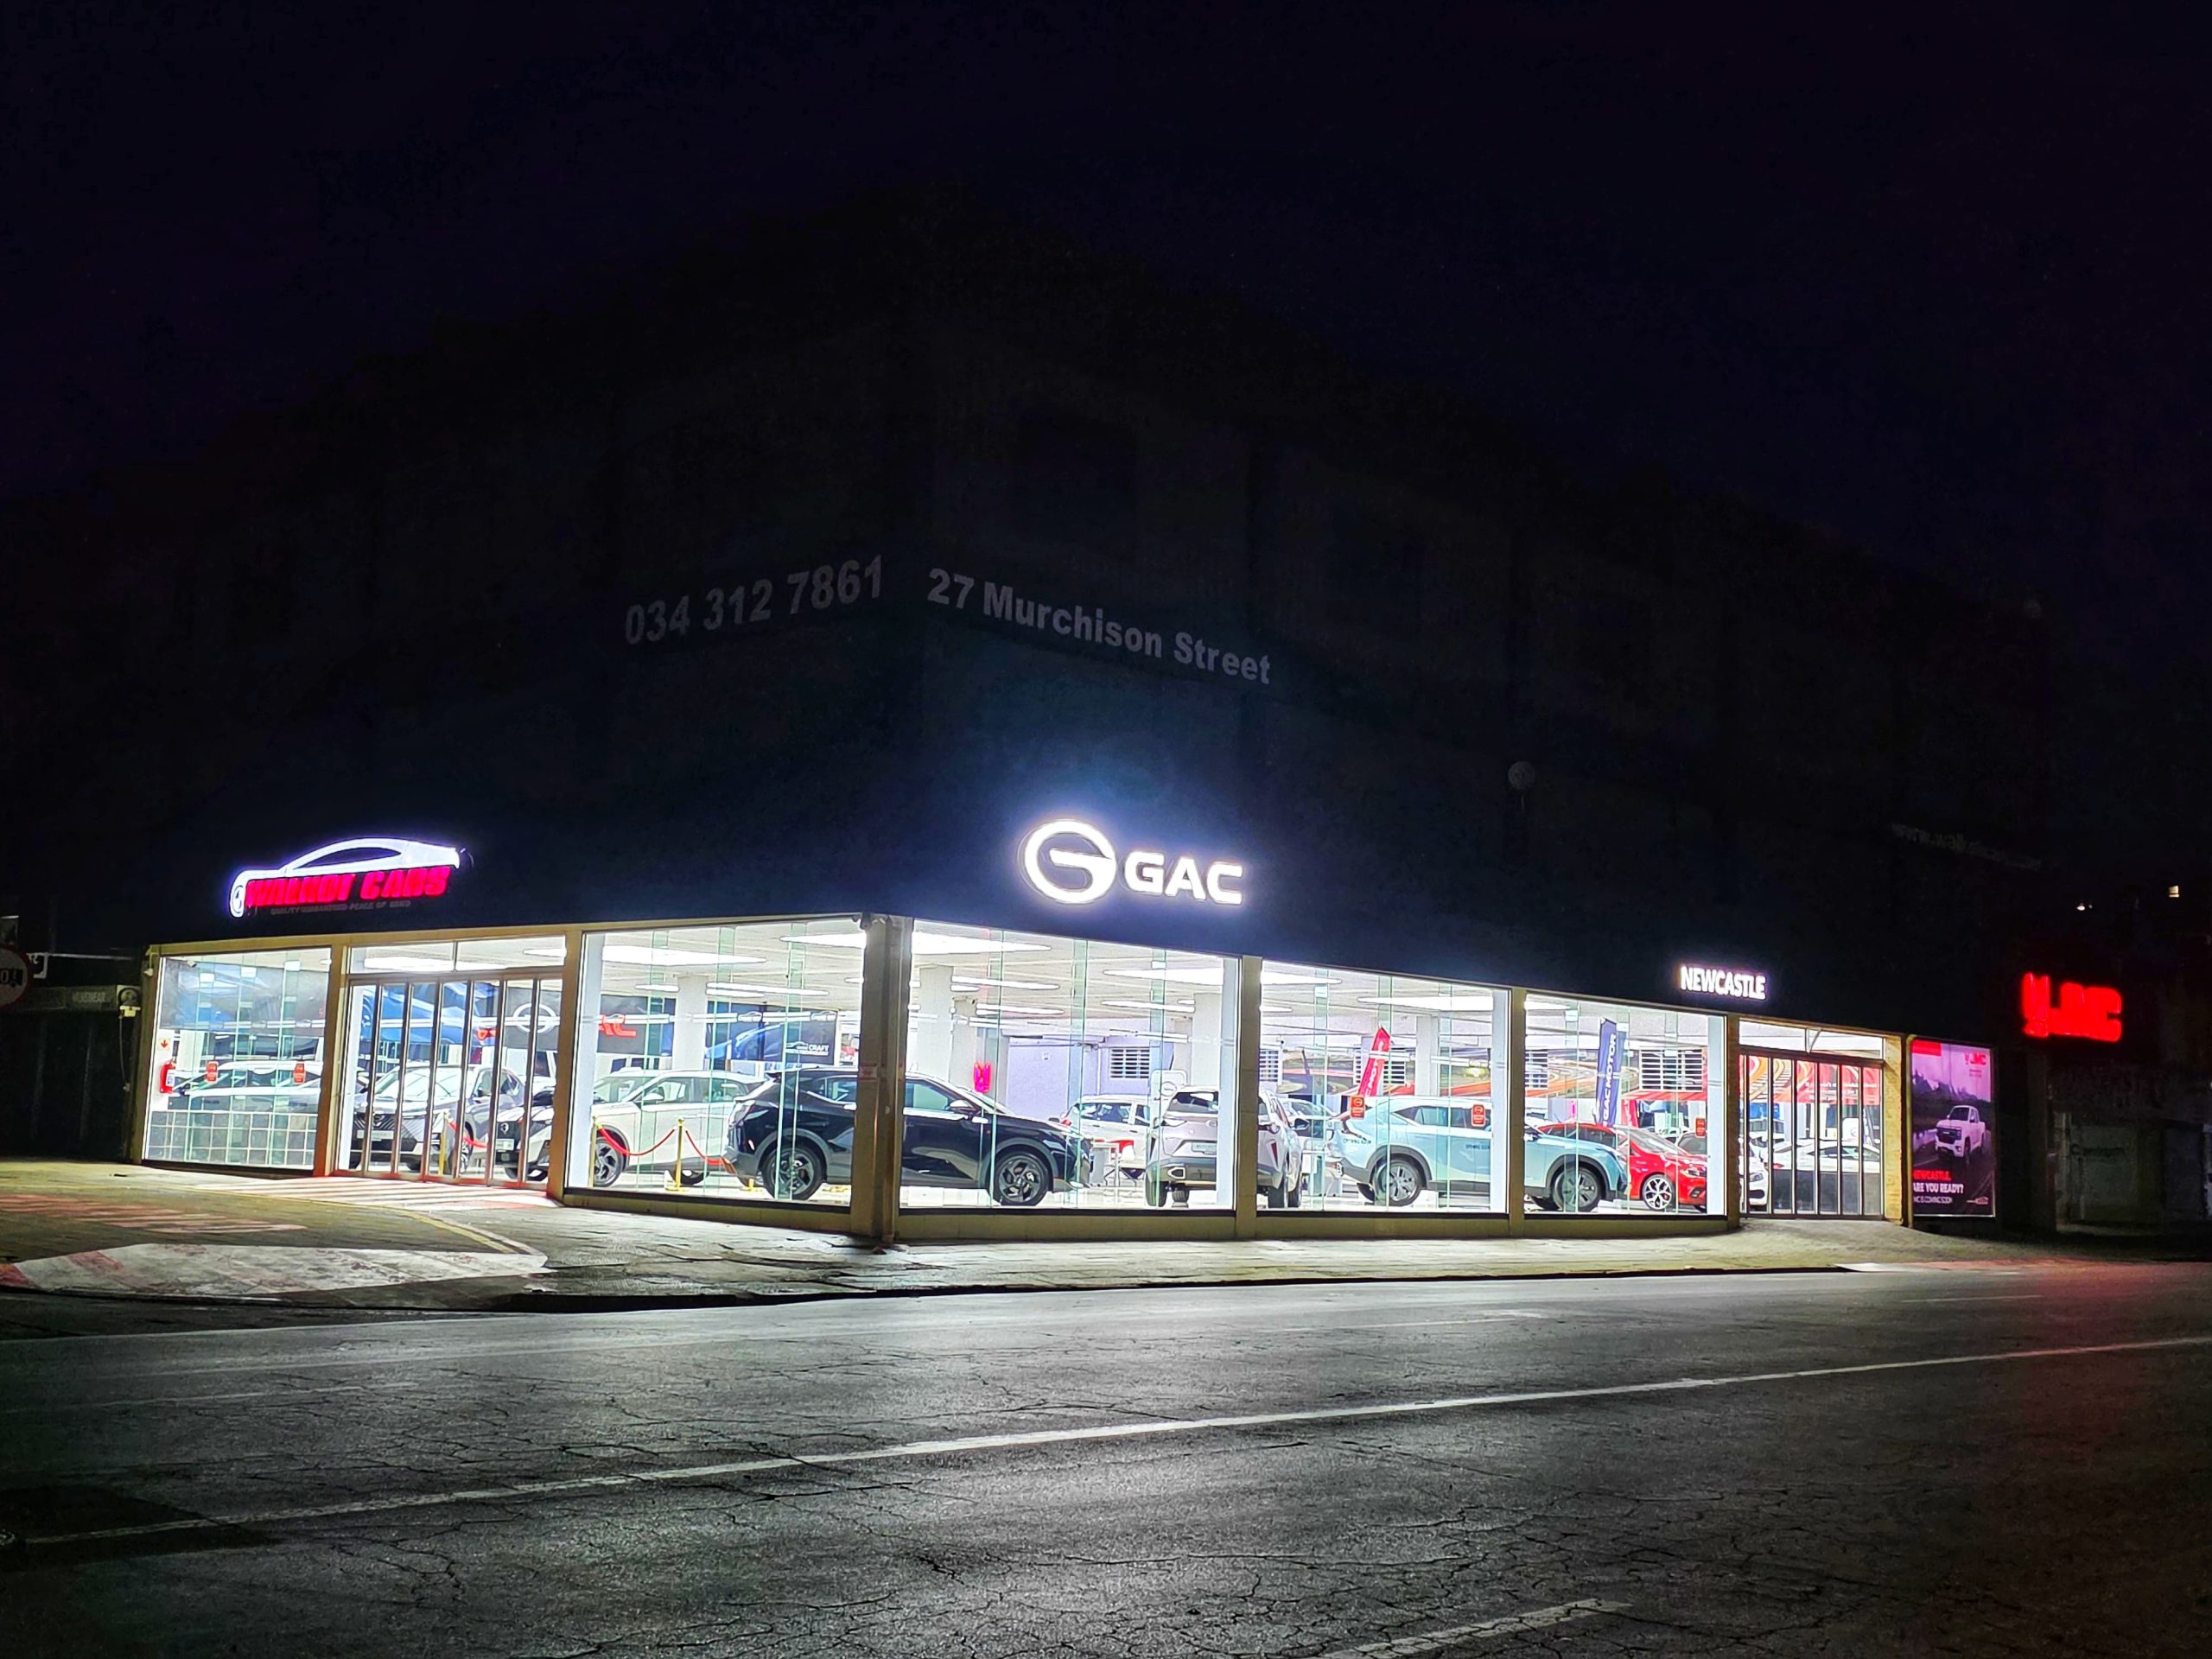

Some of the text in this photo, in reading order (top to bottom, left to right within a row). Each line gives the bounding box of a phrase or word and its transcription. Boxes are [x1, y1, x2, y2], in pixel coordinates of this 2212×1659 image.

[623, 554, 884, 645] 034 312 7861
[926, 567, 1272, 685] 27 Murchison Street
[359, 865, 452, 900] CARS
[1123, 850, 1244, 905] GAC
[1680, 964, 1767, 1001] NEWCASTLE
[1605, 1033, 1617, 1088] MOTOR
[1913, 1182, 1964, 1193] ARE YOU READY?
